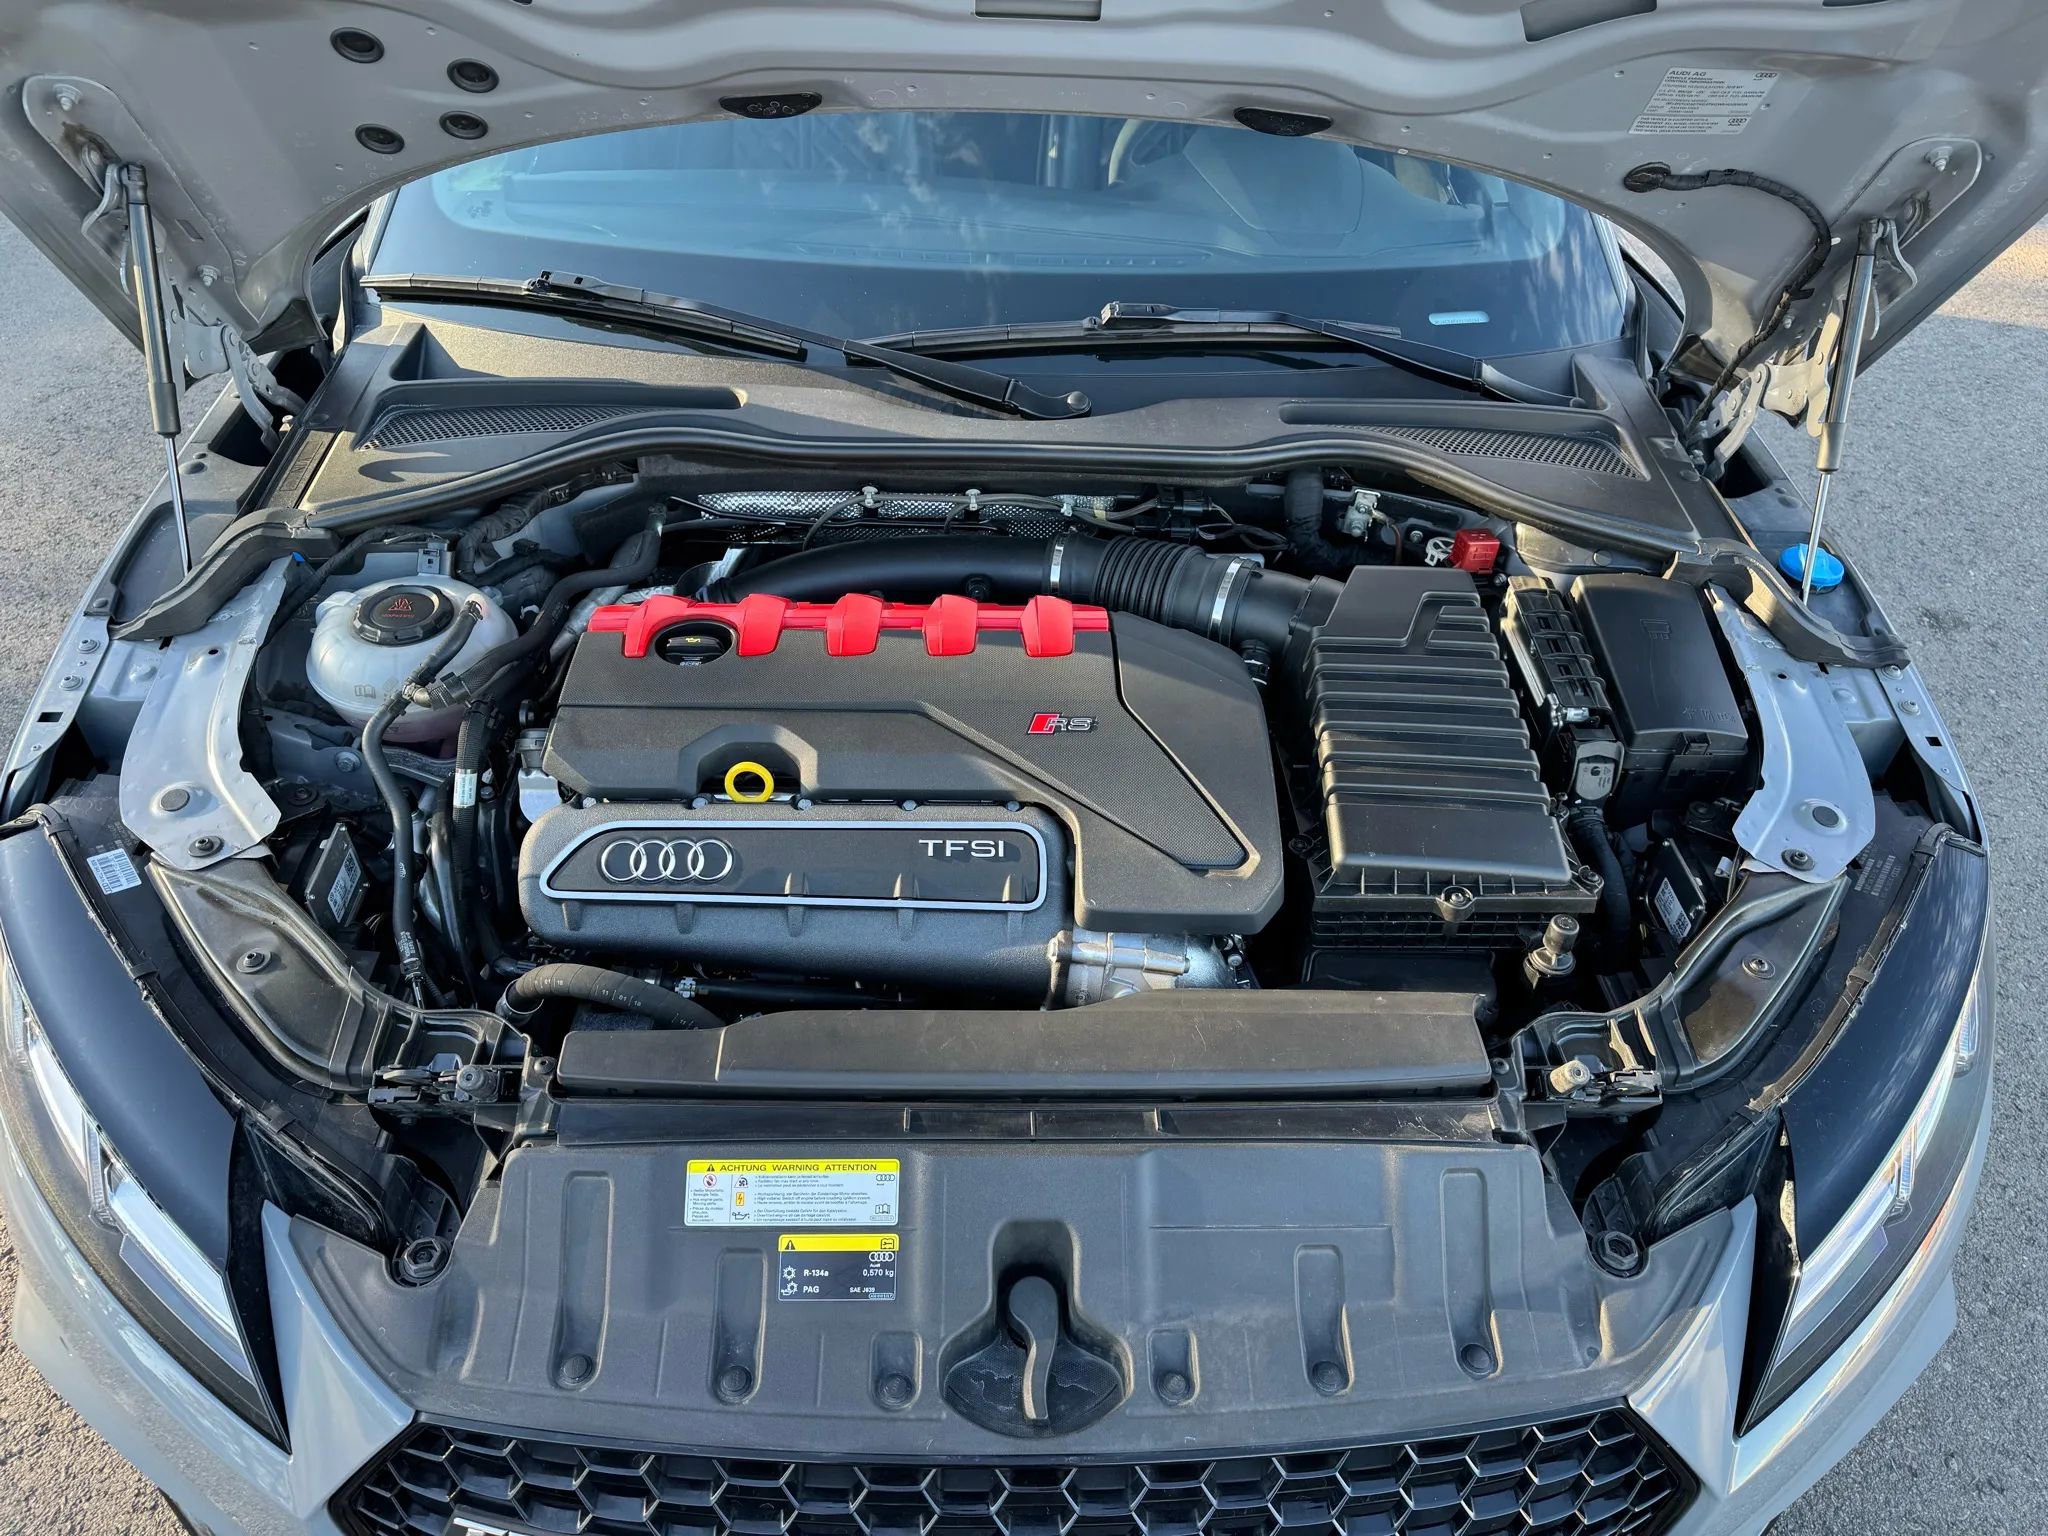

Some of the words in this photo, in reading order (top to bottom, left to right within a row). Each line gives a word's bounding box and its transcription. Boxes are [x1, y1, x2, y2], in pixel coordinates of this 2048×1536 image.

[1041, 716, 1093, 732] RS
[918, 839, 1005, 858] TFSI
[720, 1163, 767, 1172] ACHTUNG
[772, 1163, 820, 1172] WARNING
[824, 1162, 877, 1172] ATTENTION
[862, 1269, 883, 1277] 0,570
[885, 1269, 894, 1278] kg
